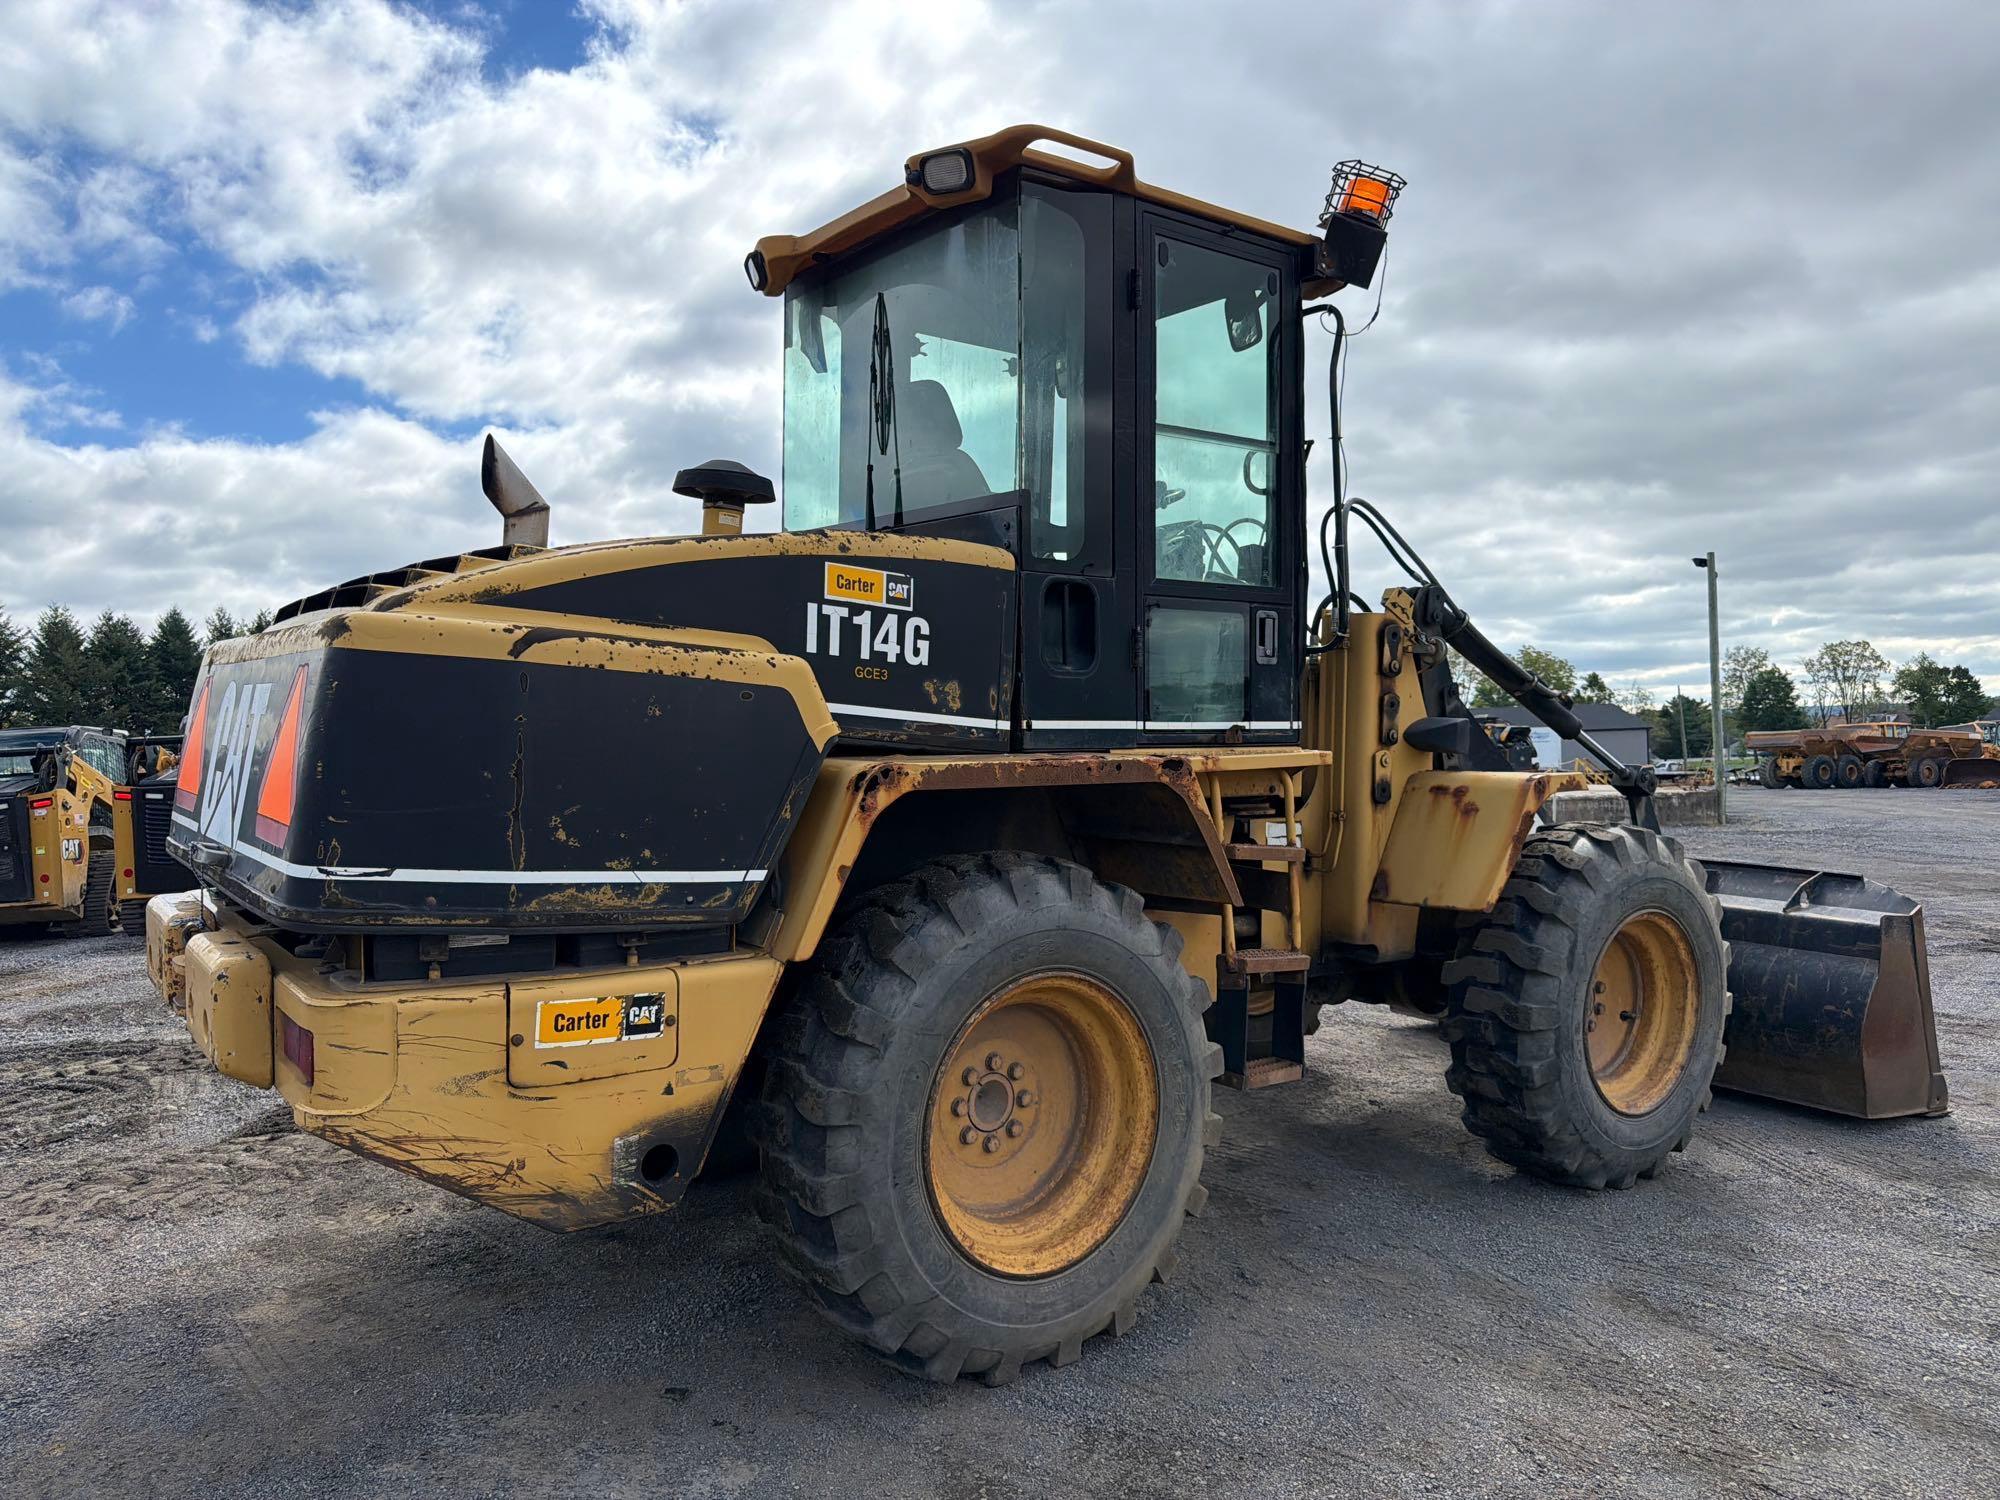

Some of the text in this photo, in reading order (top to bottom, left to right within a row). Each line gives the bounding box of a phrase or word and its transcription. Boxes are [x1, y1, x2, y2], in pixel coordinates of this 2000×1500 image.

[836, 574, 909, 599] Carter CAT
[806, 602, 930, 666] IT14G
[854, 666, 888, 680] GCE3
[200, 680, 272, 850] CAT
[62, 839, 80, 860] CAT
[553, 1005, 659, 1033] Carter CAT
